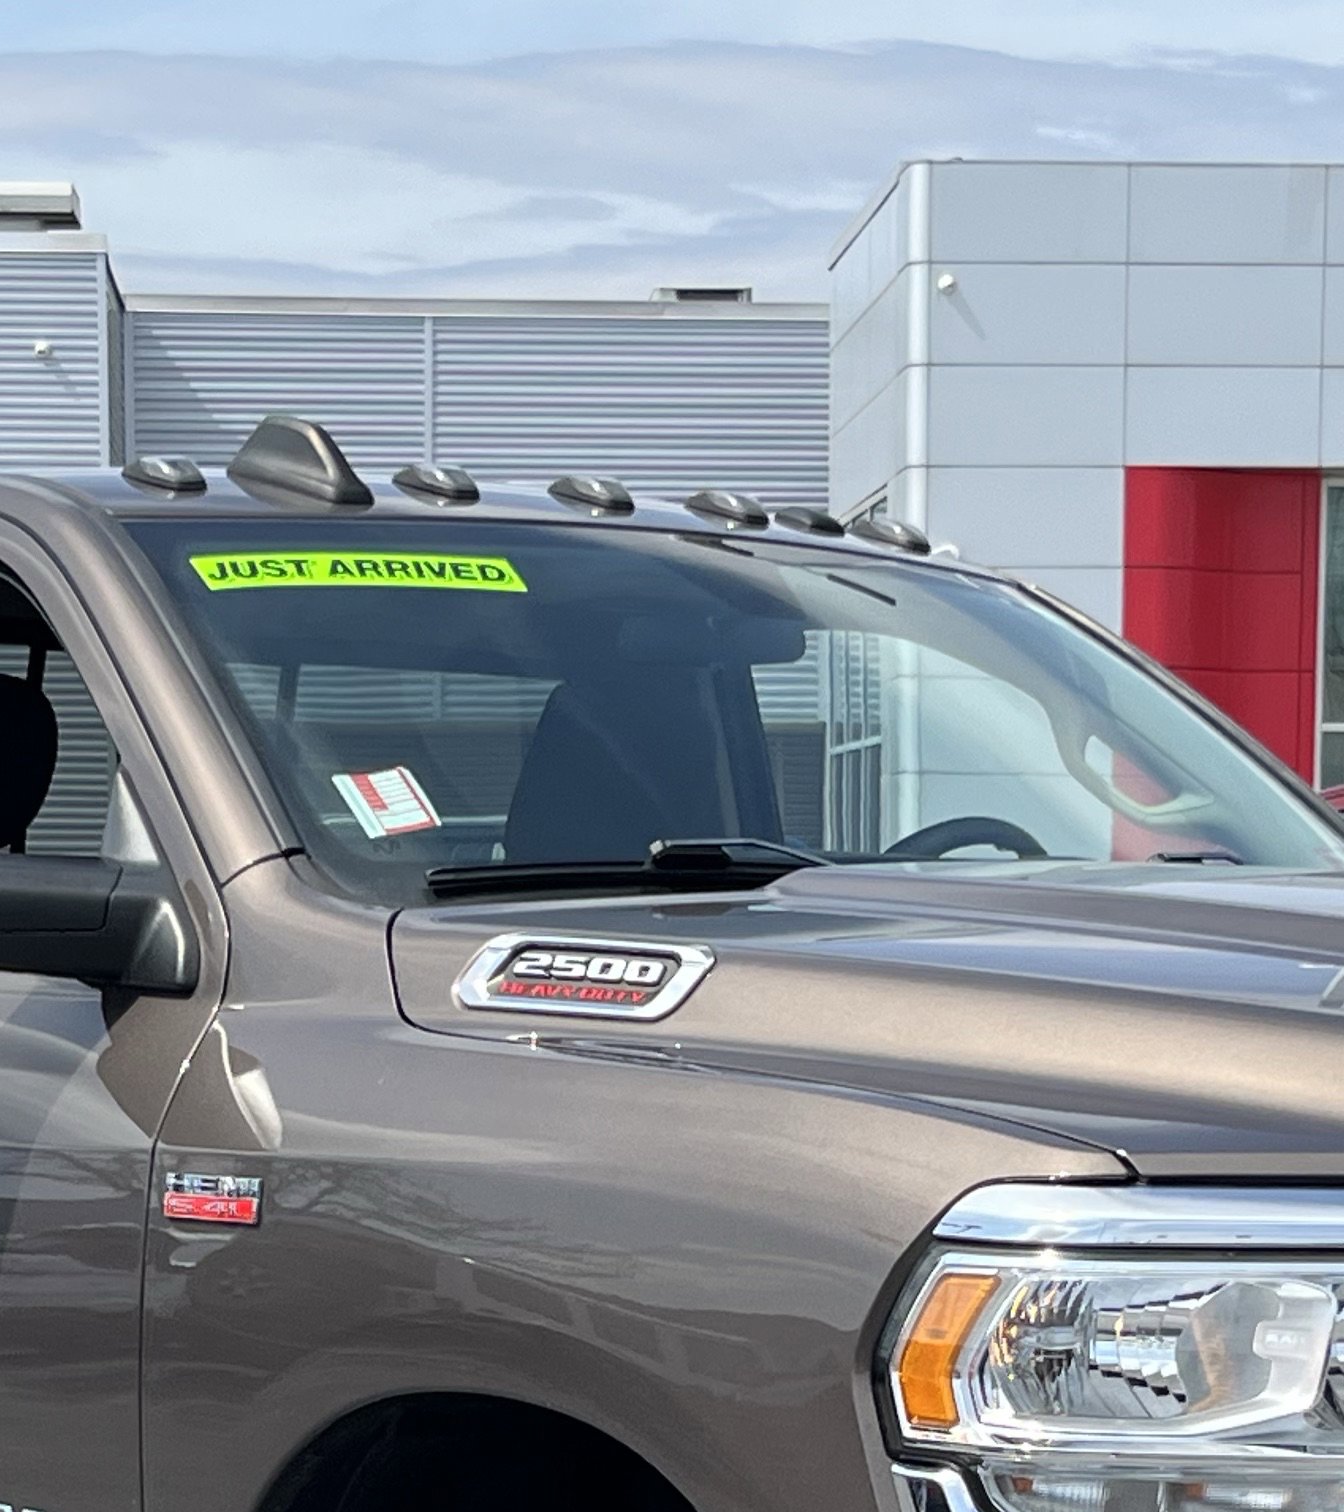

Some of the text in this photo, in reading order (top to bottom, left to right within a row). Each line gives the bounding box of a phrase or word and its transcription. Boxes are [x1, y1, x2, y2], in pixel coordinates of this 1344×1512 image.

[208, 558, 508, 583] JUST ARRIVED
[513, 952, 666, 986] 2500
[499, 980, 646, 1004] HEAVY DUTY
